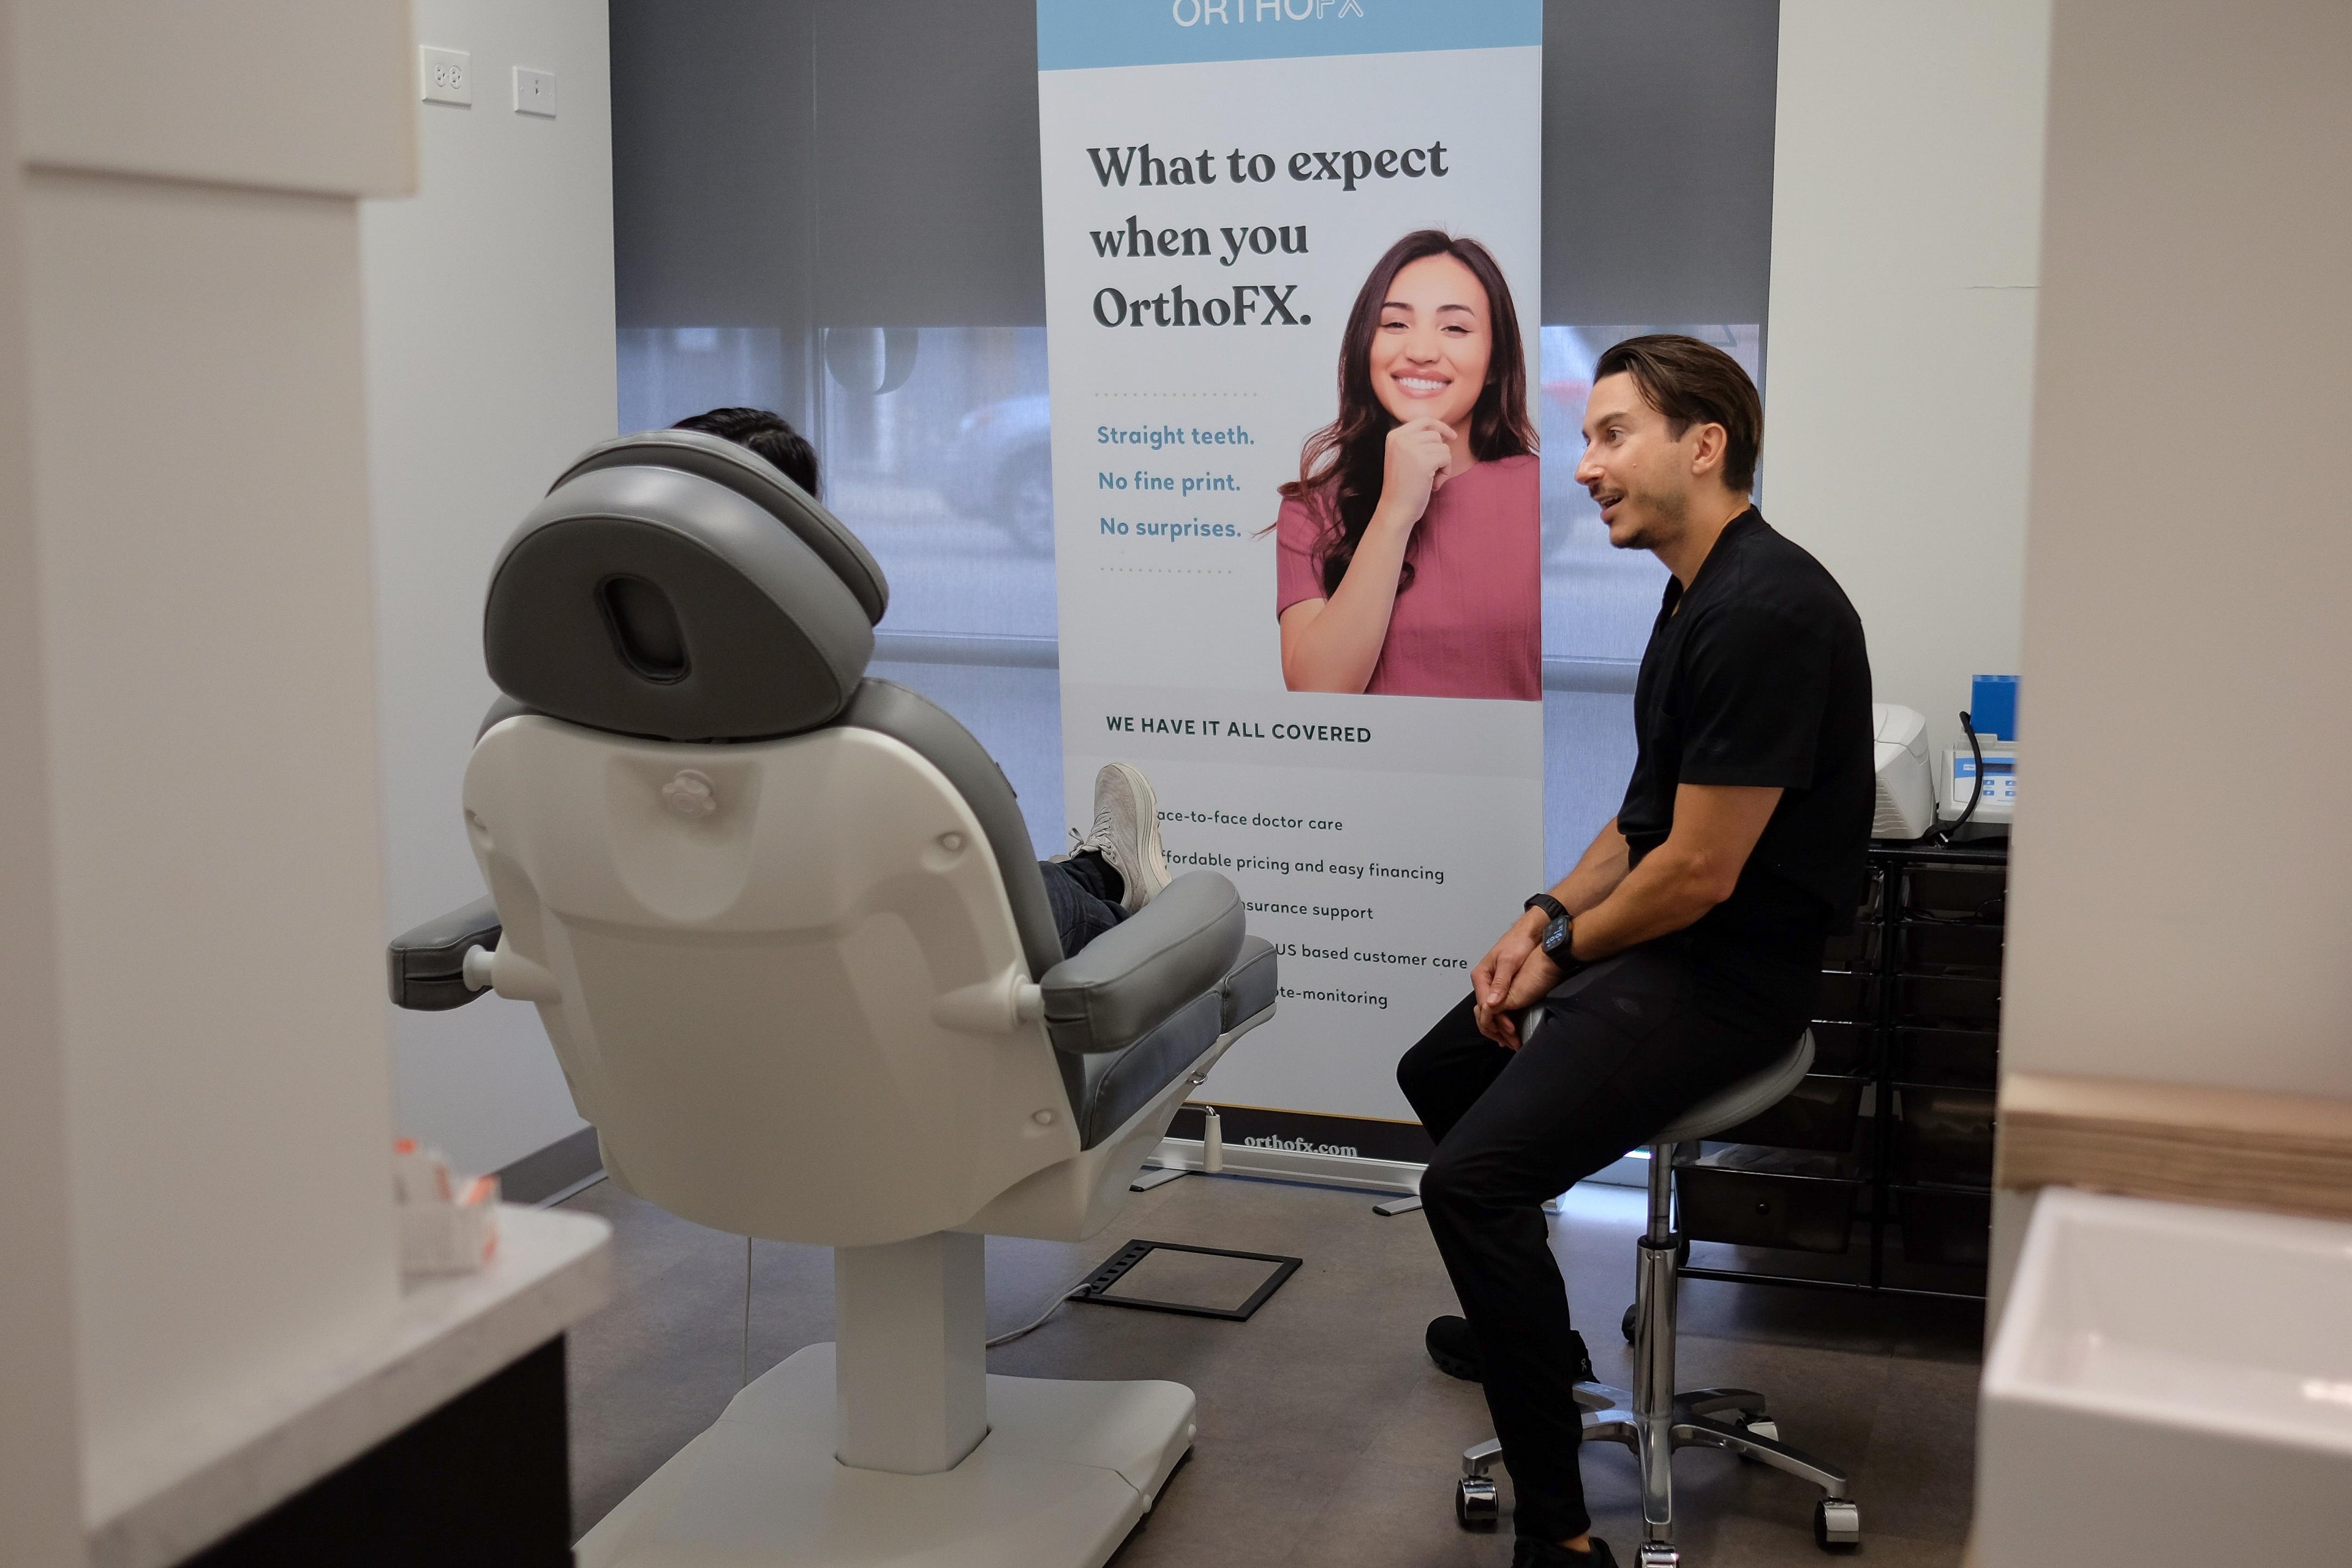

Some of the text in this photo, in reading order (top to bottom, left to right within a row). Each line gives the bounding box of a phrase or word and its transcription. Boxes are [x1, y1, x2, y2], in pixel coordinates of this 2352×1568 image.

[1172, 0, 1363, 27] ORTHOFX
[1087, 141, 1449, 192] What to expect
[1090, 215, 1309, 267] when you
[1093, 284, 1312, 328] OrthoFX.
[1097, 425, 1254, 450] Straight teeth.
[1098, 471, 1240, 497] No fine print.
[1100, 518, 1241, 542] No surprises.
[1106, 716, 1371, 743] WE HAVE IT ALL COVERED
[1157, 810, 1343, 831] ace-to-face doctor care
[1237, 856, 1289, 875] pricing
[1294, 859, 1324, 873] and
[1329, 864, 1364, 879] easy
[1369, 863, 1444, 884] financing
[1313, 906, 1374, 922] support
[1276, 944, 1468, 969] US based customer care
[1276, 986, 1387, 1009] te-monitoring
[1244, 1134, 1358, 1158] orthofx.com
